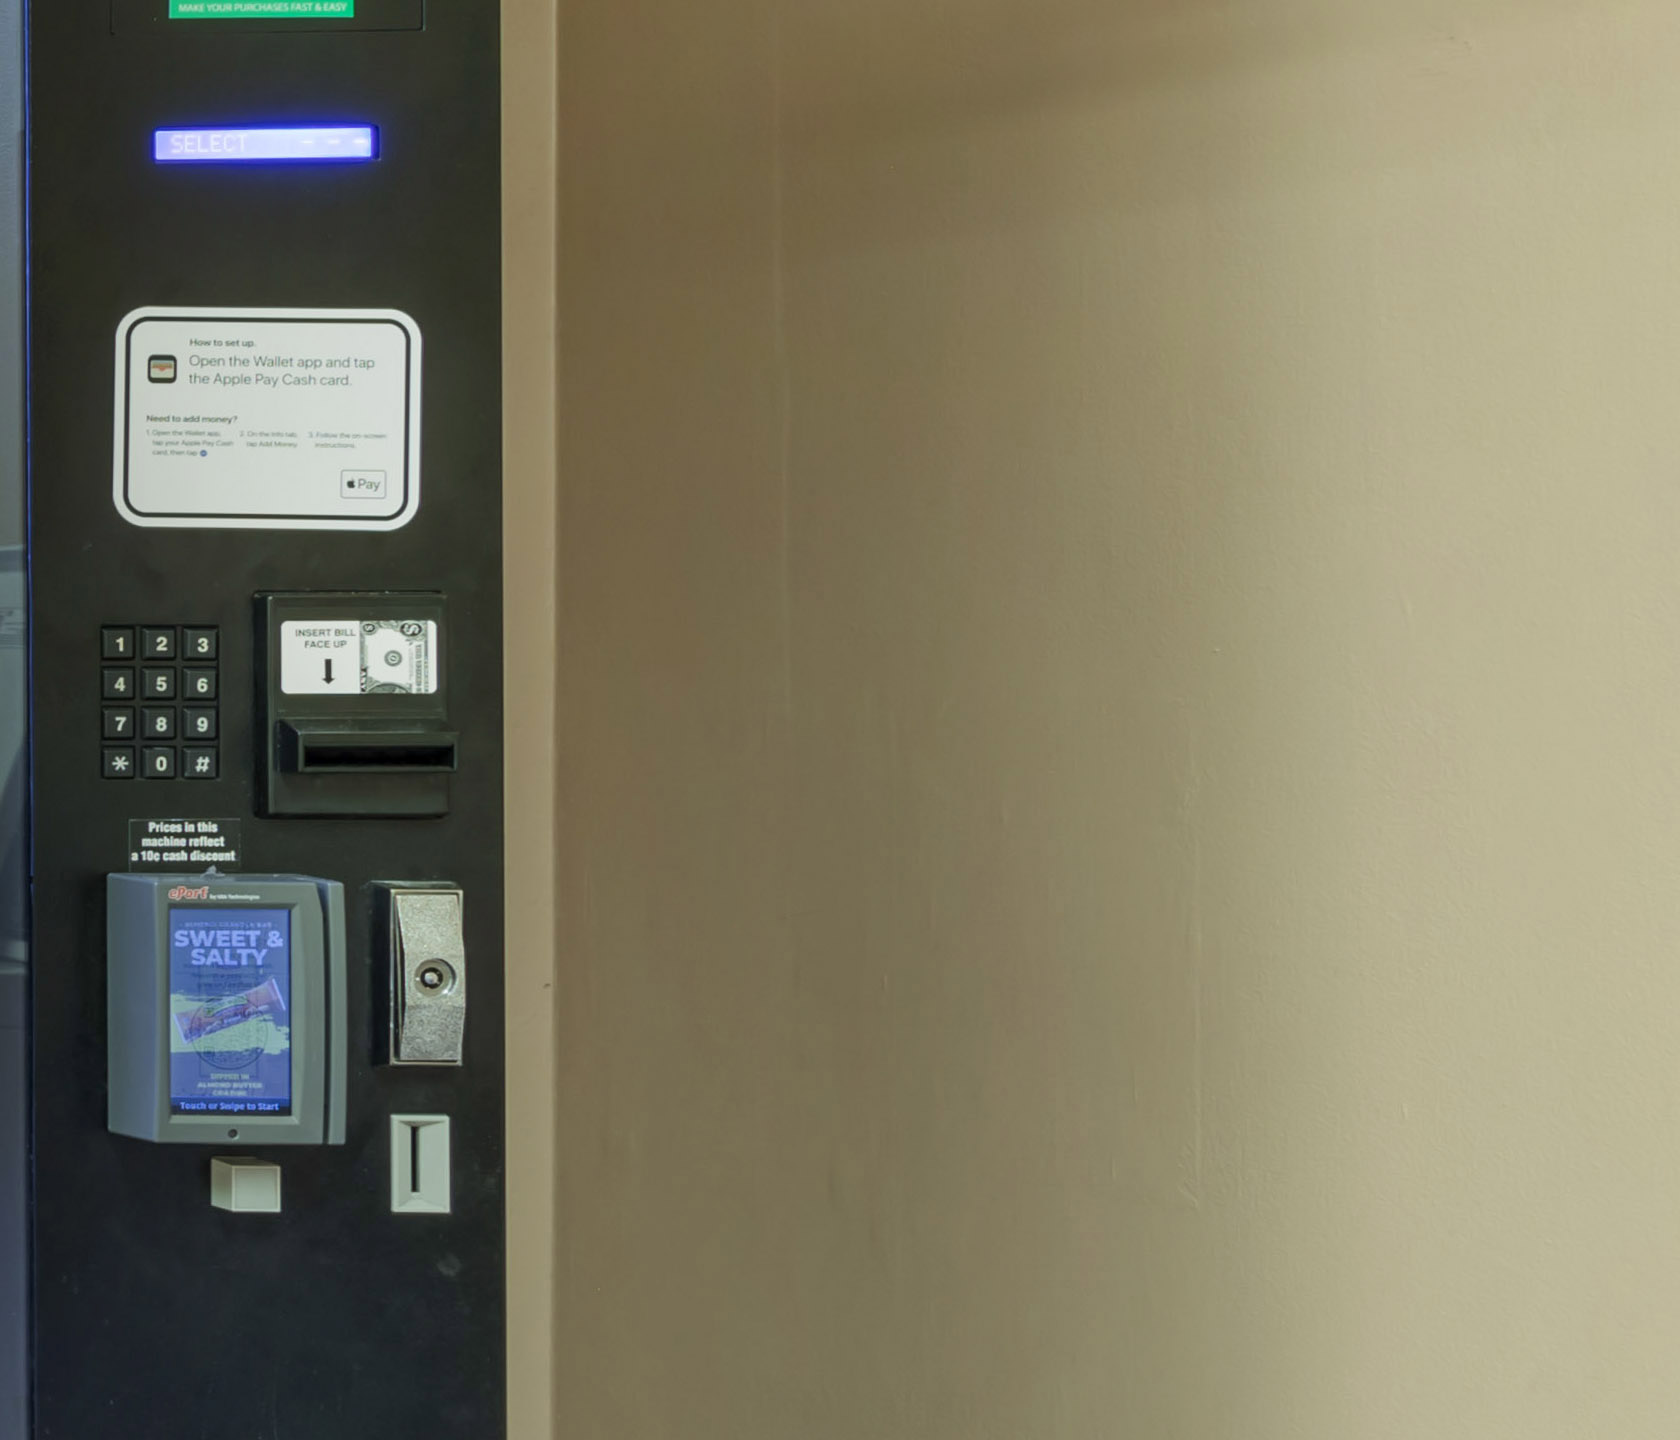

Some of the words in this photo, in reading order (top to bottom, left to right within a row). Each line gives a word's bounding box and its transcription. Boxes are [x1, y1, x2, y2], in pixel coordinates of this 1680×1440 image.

[189, 356, 225, 369] Open
[229, 356, 250, 367] the
[253, 356, 294, 368] Wallet
[297, 358, 322, 371] app
[326, 358, 350, 369] and
[354, 358, 374, 371] tap
[189, 373, 209, 385] the
[214, 373, 252, 387] Apple
[256, 374, 279, 388] Pay
[283, 374, 315, 386] Cash
[320, 375, 352, 386] card.
[295, 629, 330, 637] INSERT
[334, 629, 356, 637] BILL
[304, 640, 330, 648] FACE
[334, 640, 347, 648] UP
[174, 930, 261, 948] SWEET
[191, 948, 267, 966] SALTY
